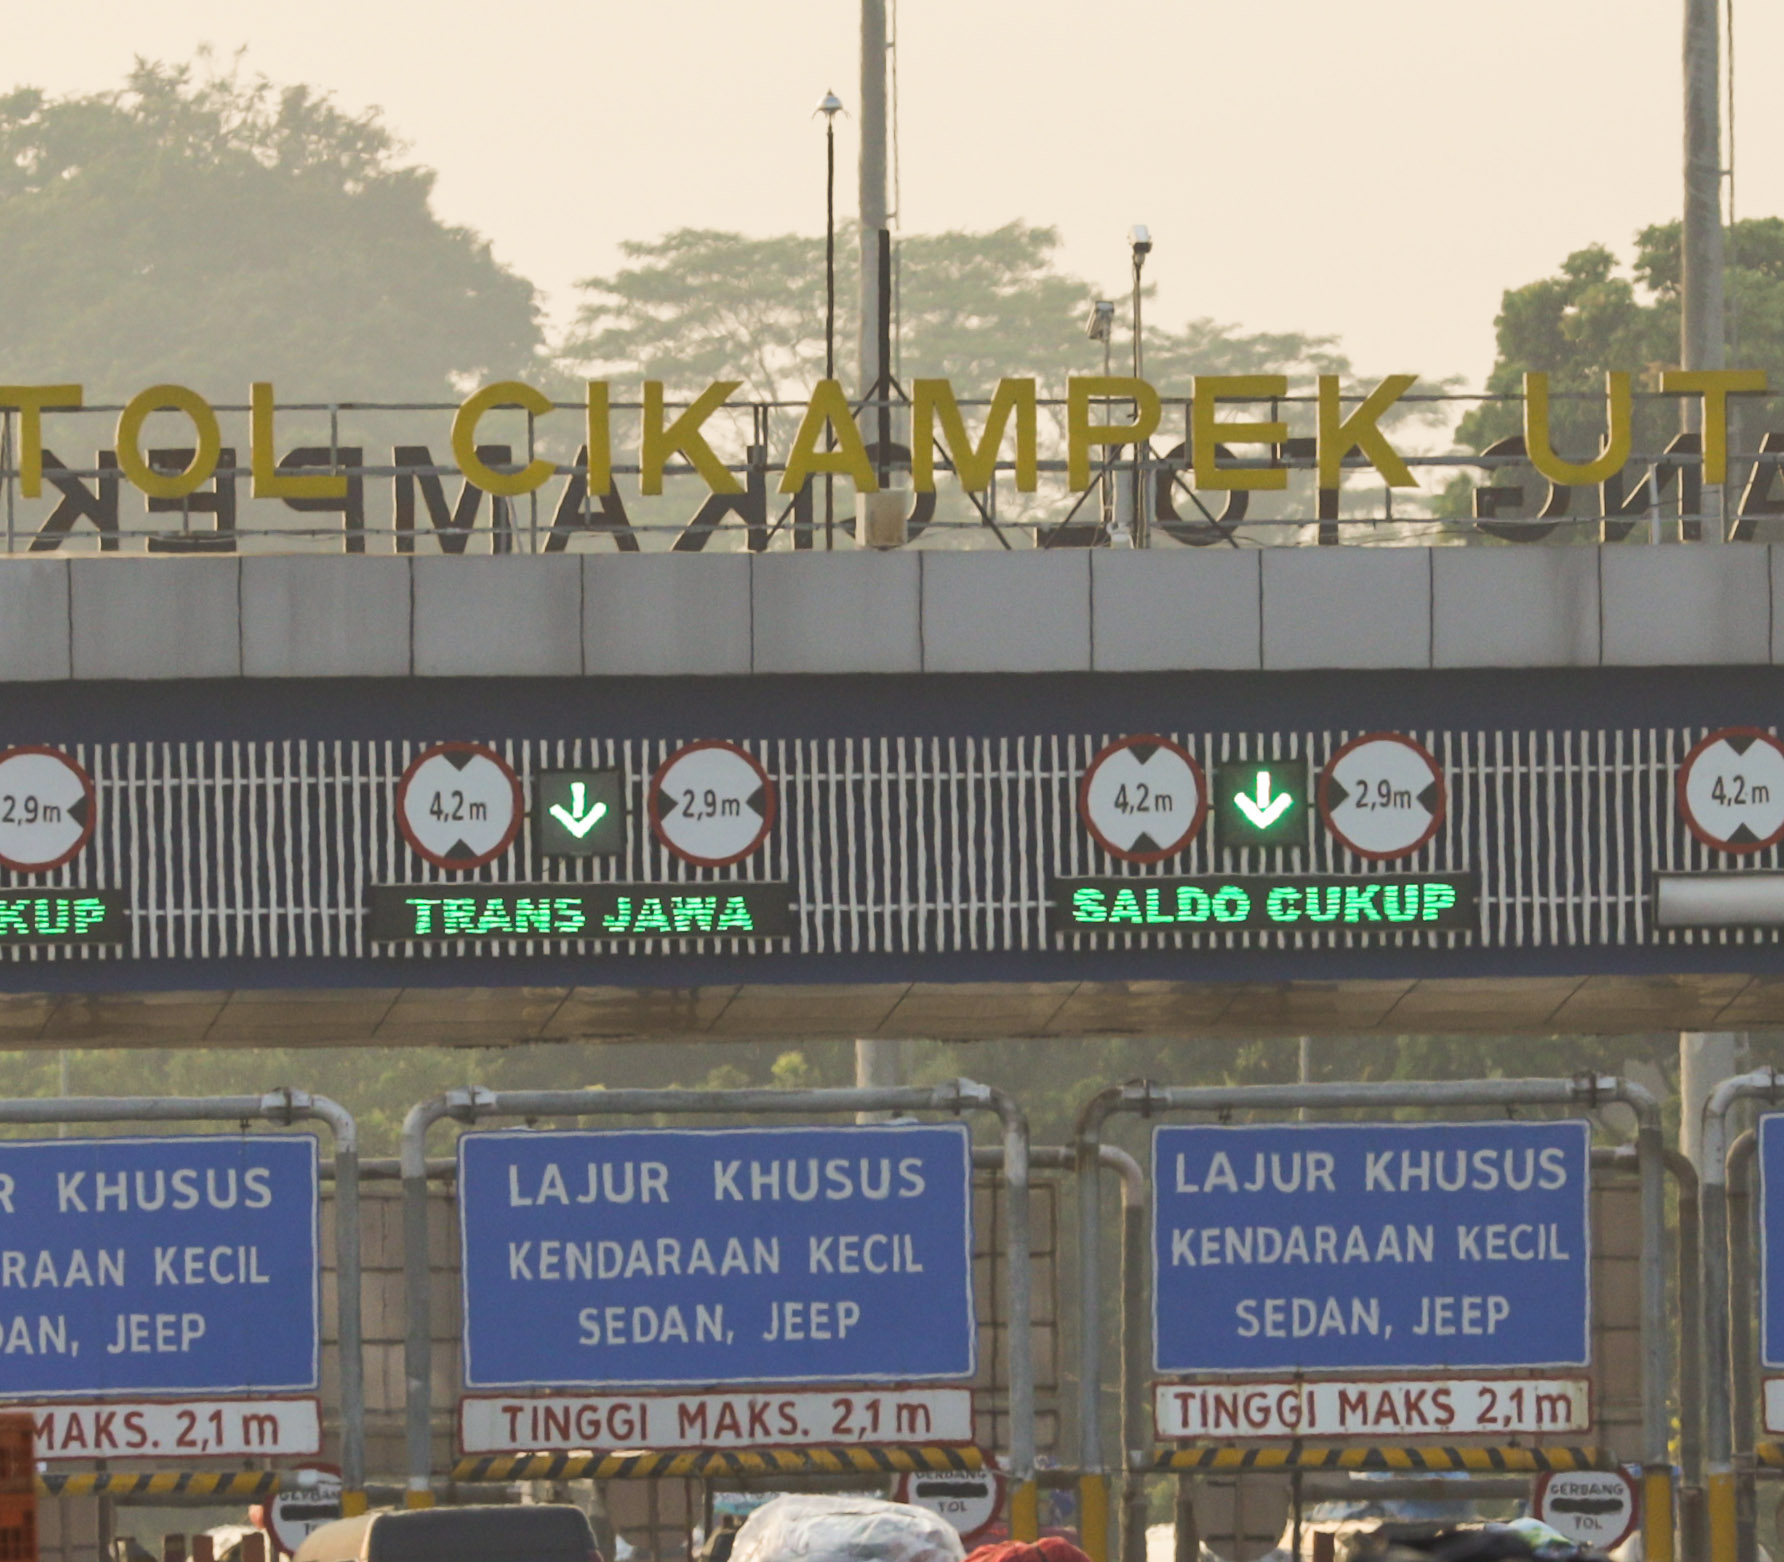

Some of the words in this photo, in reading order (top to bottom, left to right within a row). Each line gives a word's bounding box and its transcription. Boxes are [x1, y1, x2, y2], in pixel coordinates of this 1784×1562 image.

[451, 373, 1421, 497] CIKAMPEK
[0, 793, 38, 828] 2,9
[428, 790, 465, 825] 4,2
[680, 789, 717, 824] 2,9
[1113, 783, 1149, 818] 4,2
[1710, 774, 1746, 808] 4,2
[405, 894, 587, 936] TRANS
[603, 894, 754, 933] JAWA
[1072, 885, 1252, 925] SALDO
[1266, 882, 1458, 924] CUKUP
[58, 1167, 273, 1213] KHUSUS
[508, 1161, 669, 1207] LAJUR
[714, 1157, 926, 1202] KHUSUS
[1175, 1150, 1335, 1195] LAJUR
[1364, 1147, 1566, 1193] KHUSUS
[154, 1245, 270, 1287] KECIL
[509, 1236, 780, 1281] KENDARAAN
[808, 1233, 923, 1275] KECIL
[1171, 1224, 1435, 1267] KENDARAAN
[1457, 1223, 1570, 1263] KECIL
[106, 1312, 206, 1354] JEEP
[578, 1303, 734, 1347] SEDAN,
[762, 1301, 861, 1342] JEEP
[1235, 1297, 1393, 1341] SEDAN,
[1411, 1295, 1510, 1336] JEEP
[501, 1402, 648, 1443] TINGGI
[677, 1399, 810, 1440] MAKS.
[831, 1398, 881, 1442] 2,1
[895, 1399, 932, 1434] m
[1173, 1391, 1317, 1430] TINGGI
[1338, 1387, 1455, 1427] MAKS
[1476, 1387, 1524, 1428] 2,1
[1535, 1389, 1573, 1423] m
[175, 1408, 225, 1453] 2,1
[242, 1410, 280, 1447] m
[938, 1500, 968, 1513] TOL
[1550, 1482, 1625, 1496] GERBANG
[1573, 1515, 1603, 1530] TOL
